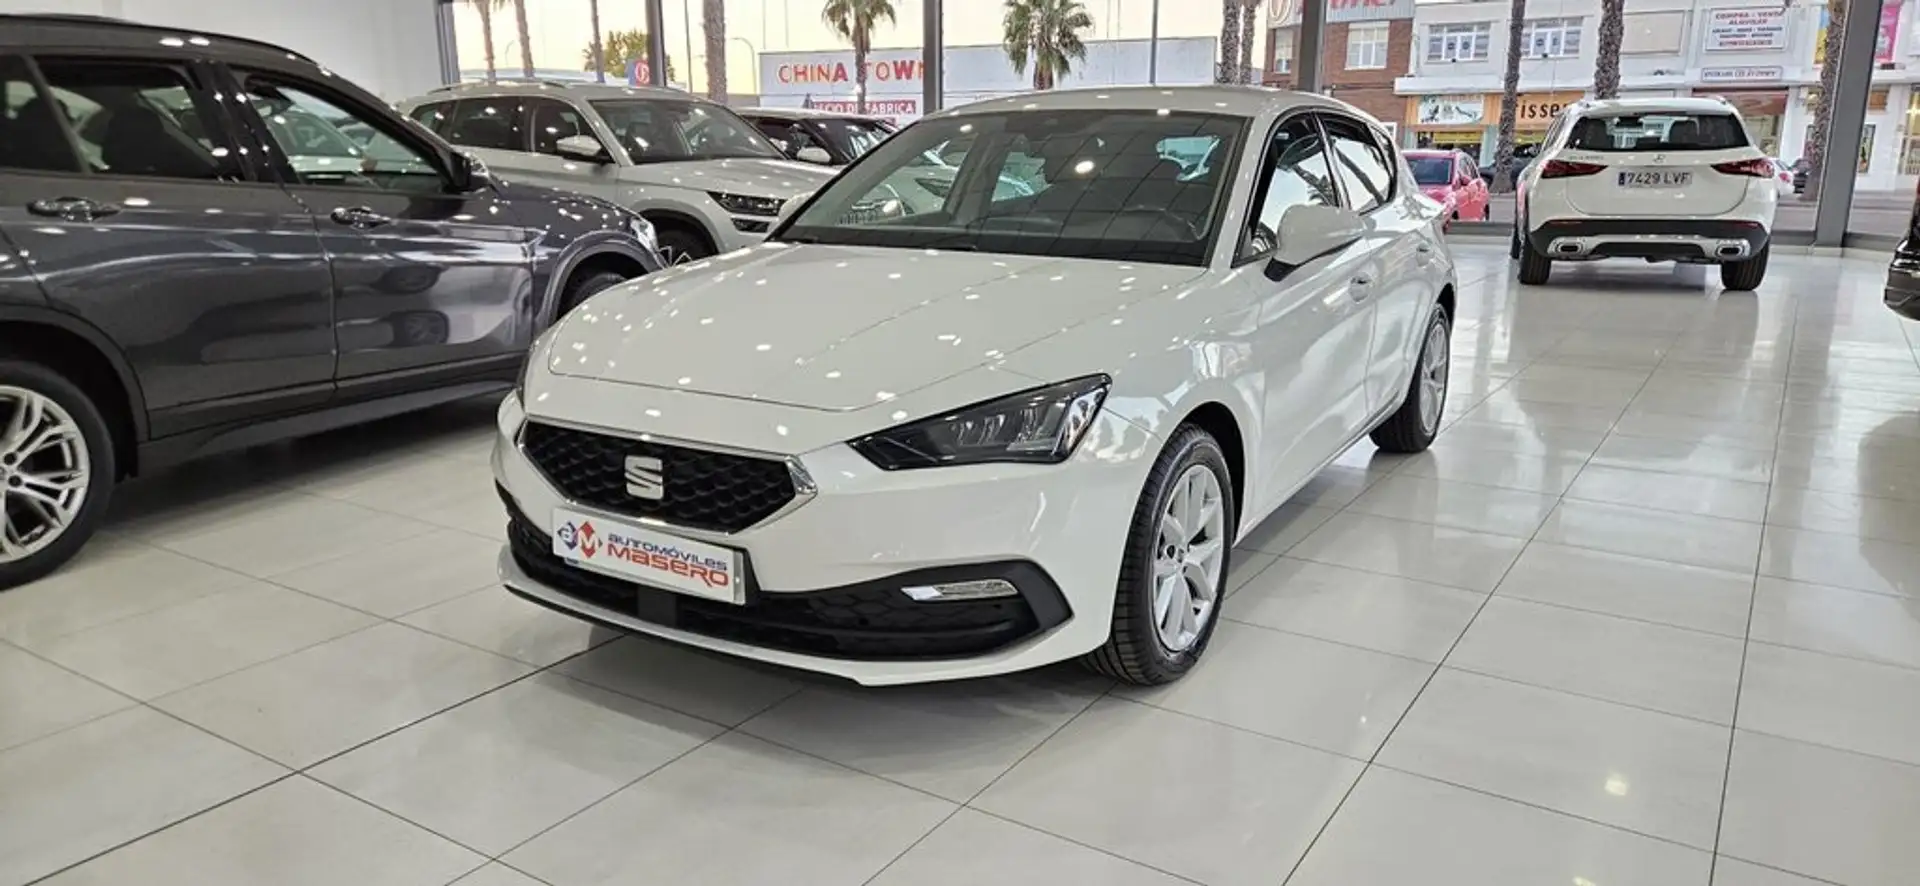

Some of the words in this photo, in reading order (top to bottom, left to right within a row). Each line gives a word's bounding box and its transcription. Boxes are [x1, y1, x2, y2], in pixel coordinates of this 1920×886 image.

[778, 62, 848, 83] CHINA
[1627, 172, 1660, 185] 7429
[1664, 172, 1690, 185] LVF
